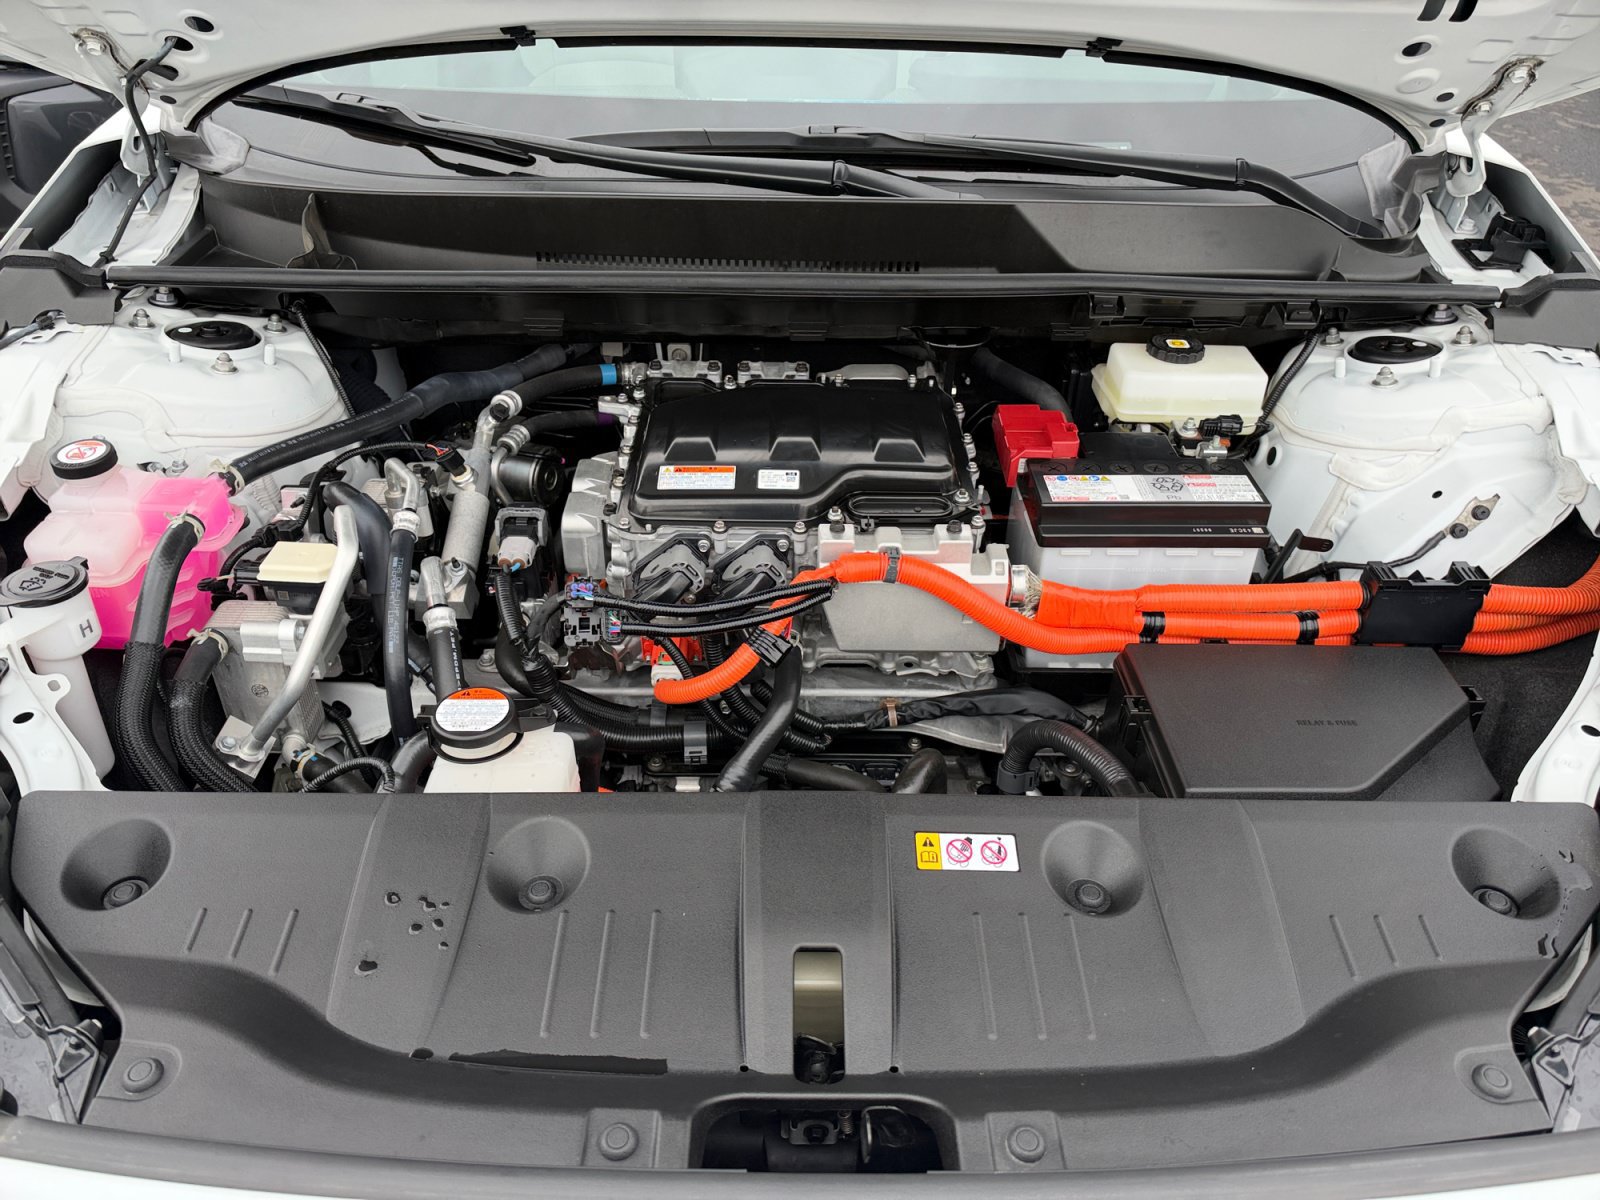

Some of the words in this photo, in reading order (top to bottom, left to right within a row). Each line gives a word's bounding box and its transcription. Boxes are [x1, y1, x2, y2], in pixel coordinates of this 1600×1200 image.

[79, 618, 93, 638] H
[1296, 719, 1324, 727] RELAY
[1335, 719, 1358, 727] FUSE
